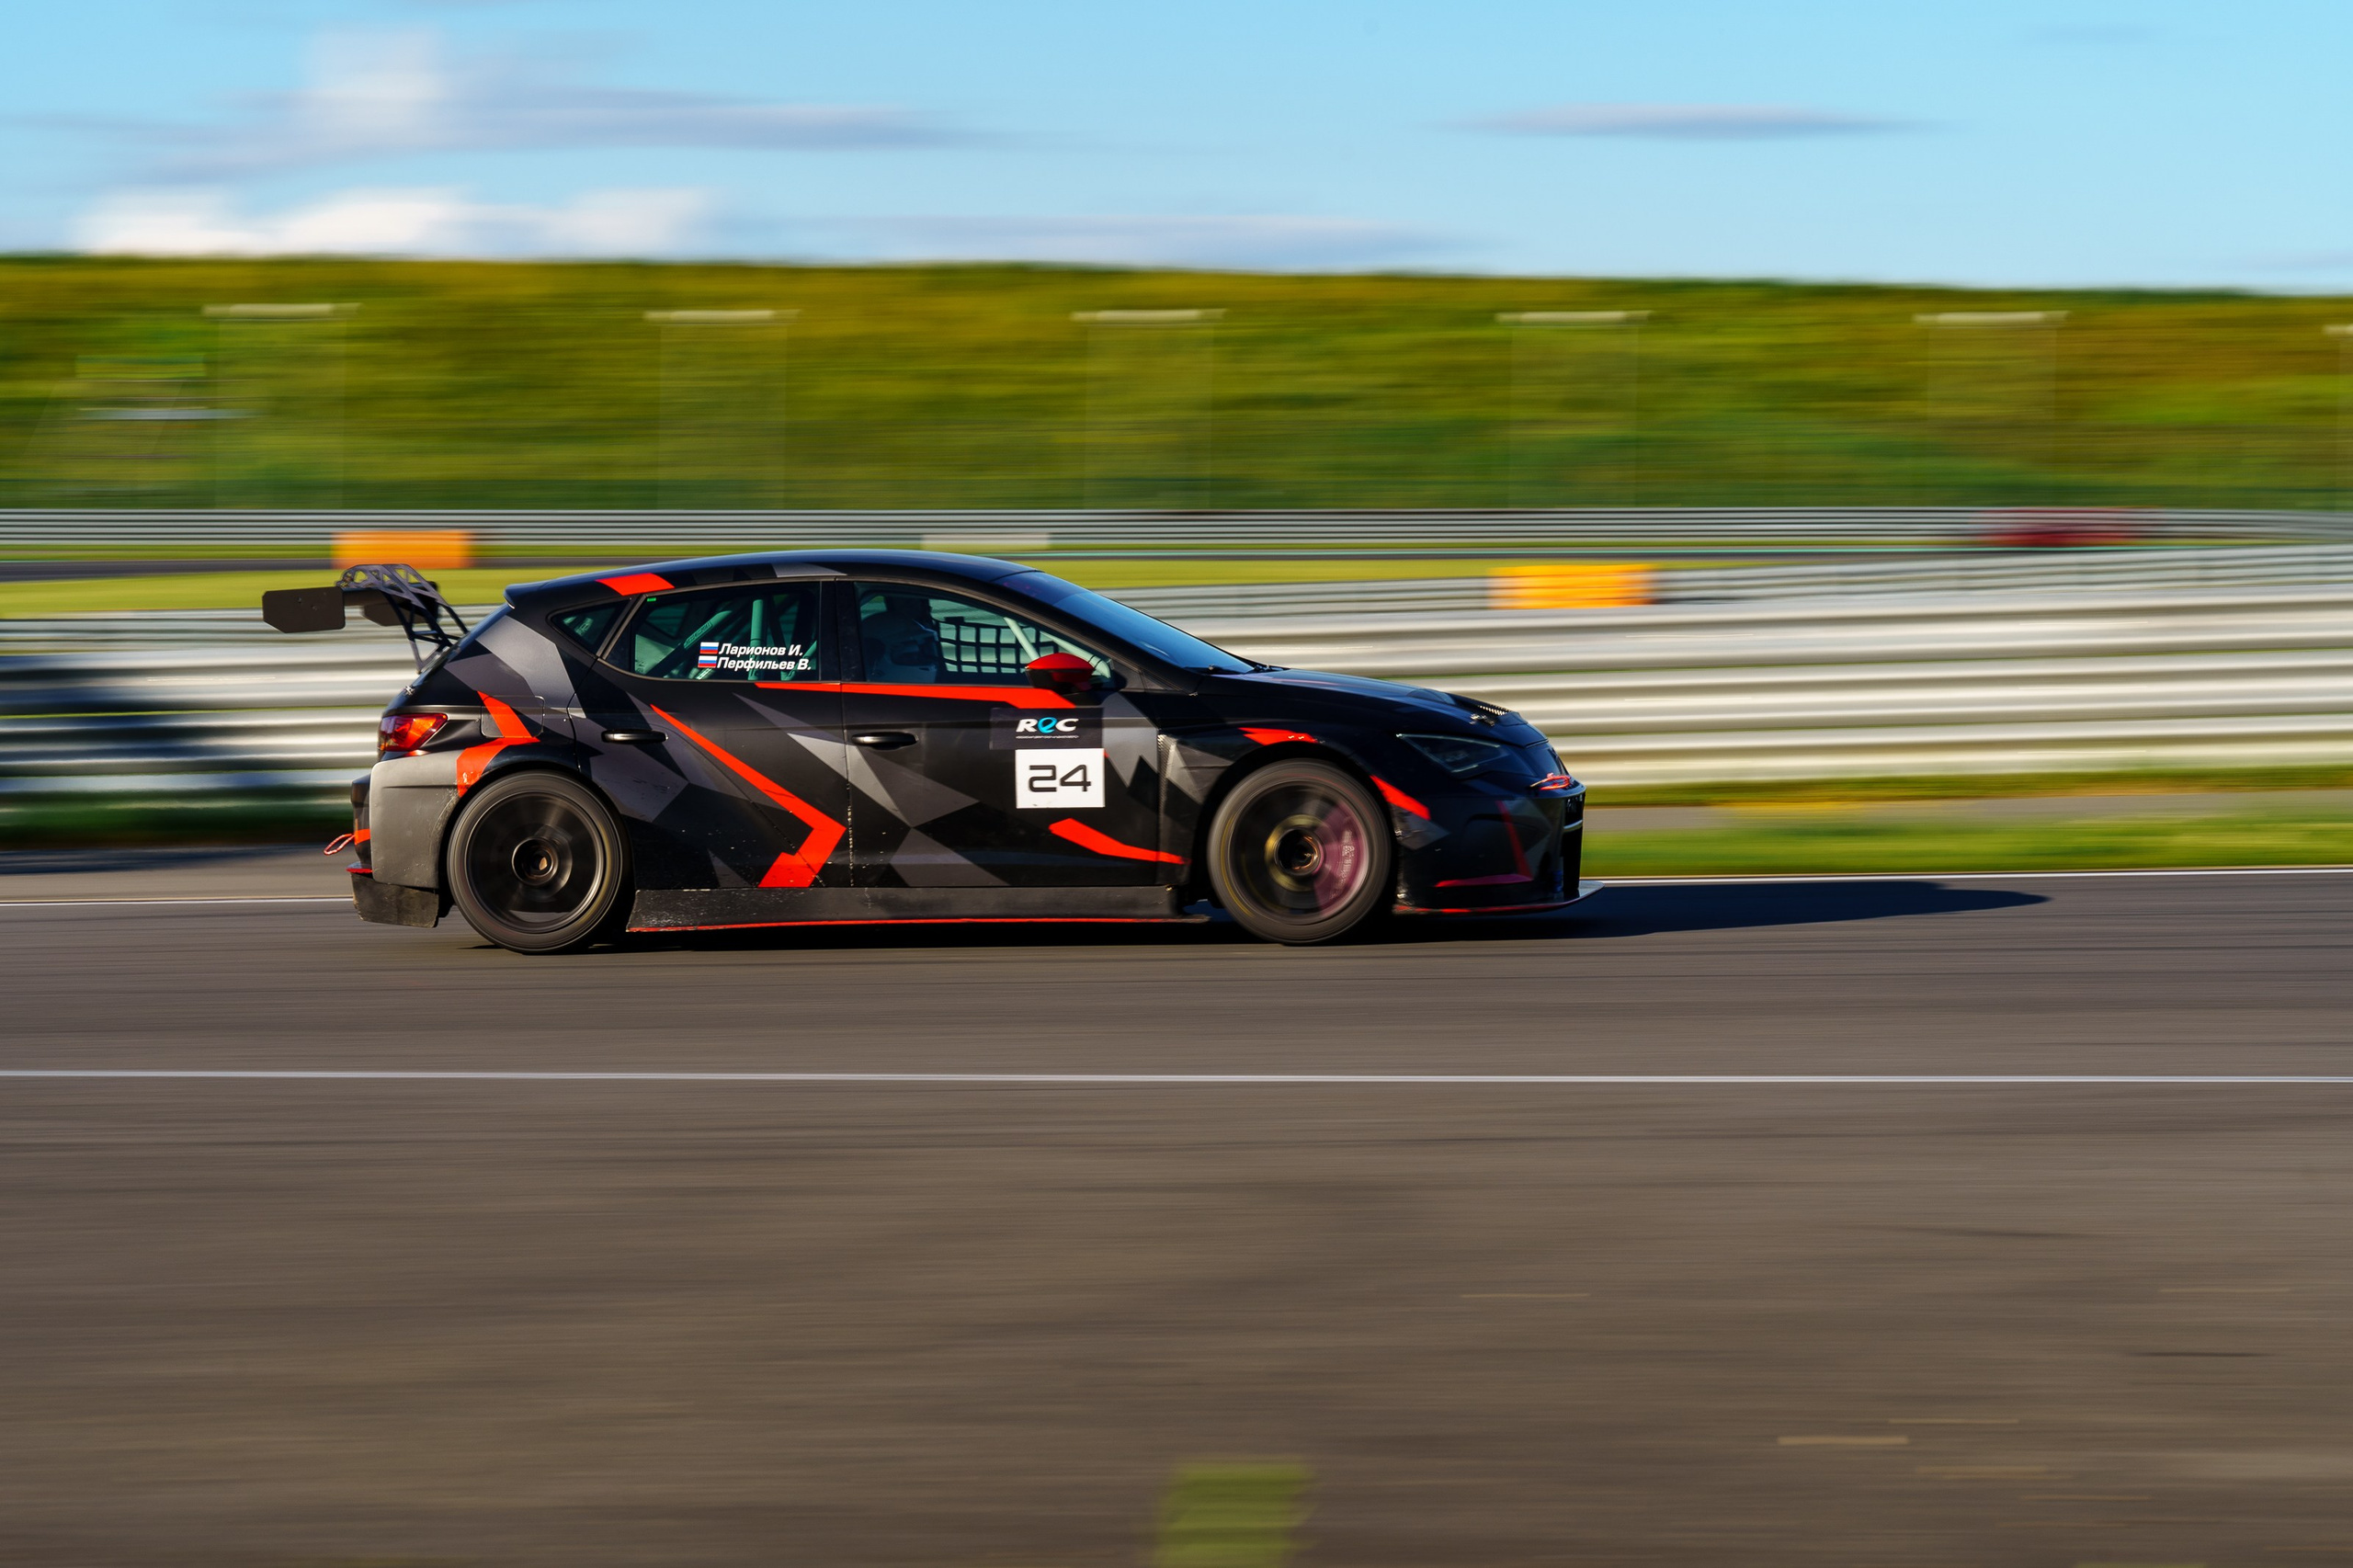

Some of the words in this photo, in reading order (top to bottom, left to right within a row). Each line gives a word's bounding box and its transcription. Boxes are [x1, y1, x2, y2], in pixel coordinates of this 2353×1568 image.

[718, 643, 786, 657] Ларионов
[788, 644, 803, 656] И.
[717, 657, 795, 671] Перфильев
[797, 658, 812, 670] В.
[1029, 764, 1091, 792] 24
